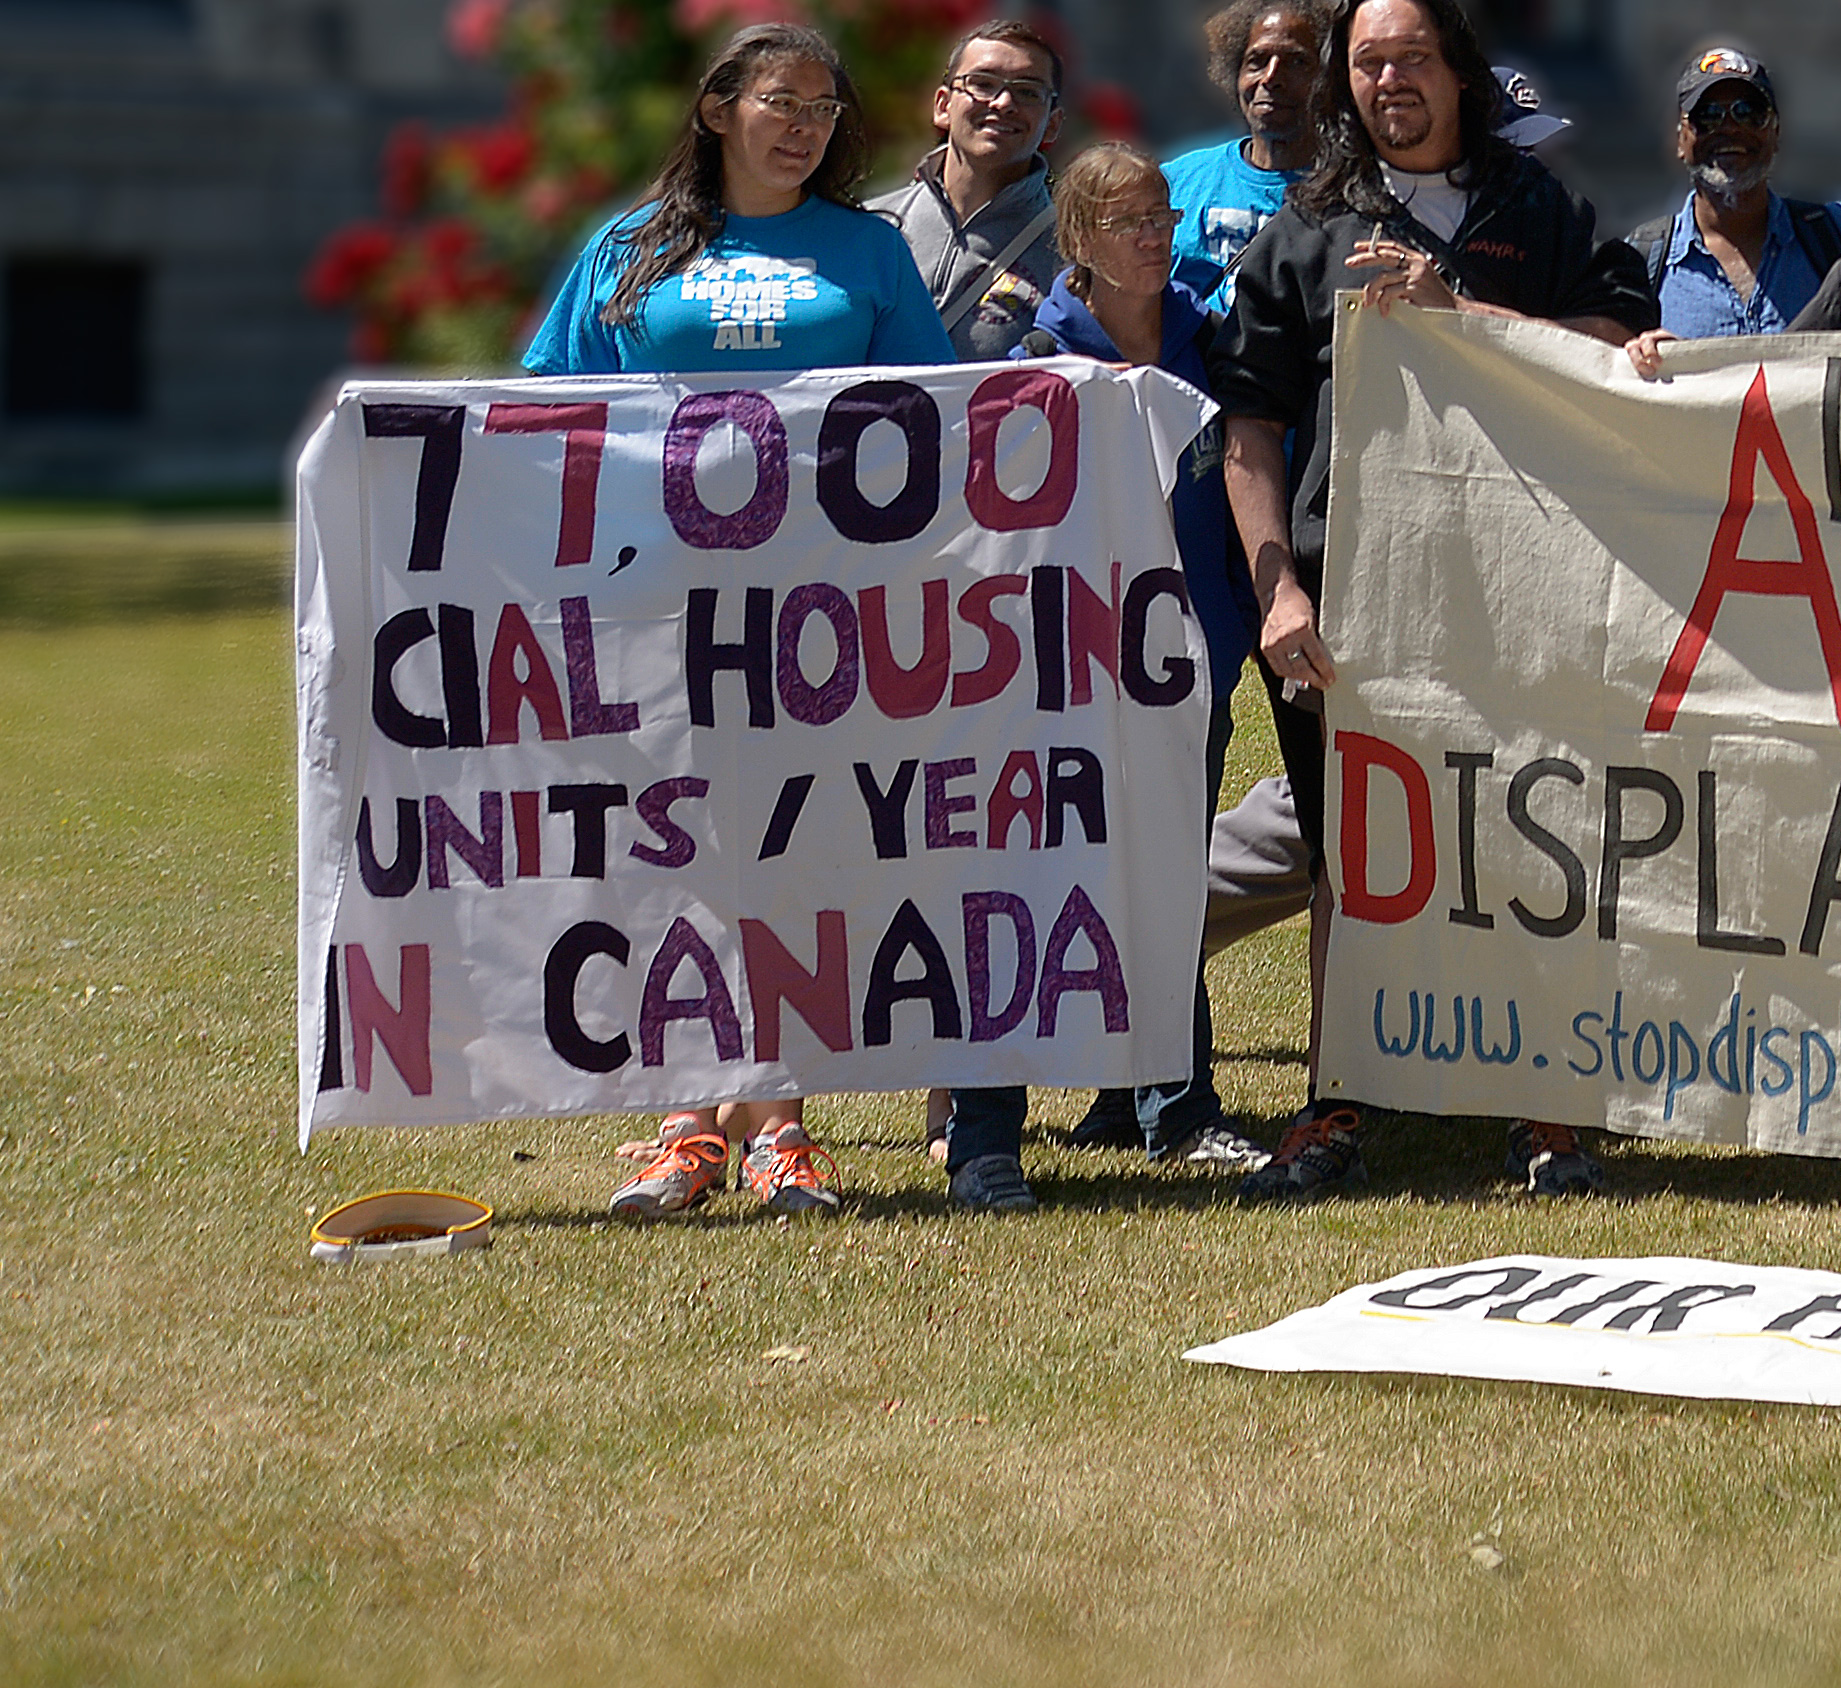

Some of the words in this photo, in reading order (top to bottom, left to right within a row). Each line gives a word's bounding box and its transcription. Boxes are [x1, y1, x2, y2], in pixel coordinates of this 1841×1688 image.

[680, 277, 818, 301] HOMES
[710, 299, 786, 321] FOR
[713, 320, 782, 350] ALL
[361, 368, 1084, 576] 77,000
[370, 596, 640, 749] CIAL
[686, 562, 1196, 730] HOUSING
[356, 777, 710, 899] UNITS
[758, 773, 815, 862] /
[853, 746, 1107, 860] YEAR
[543, 884, 1131, 1074] CANADA
[1368, 1265, 1758, 1333] OUR
